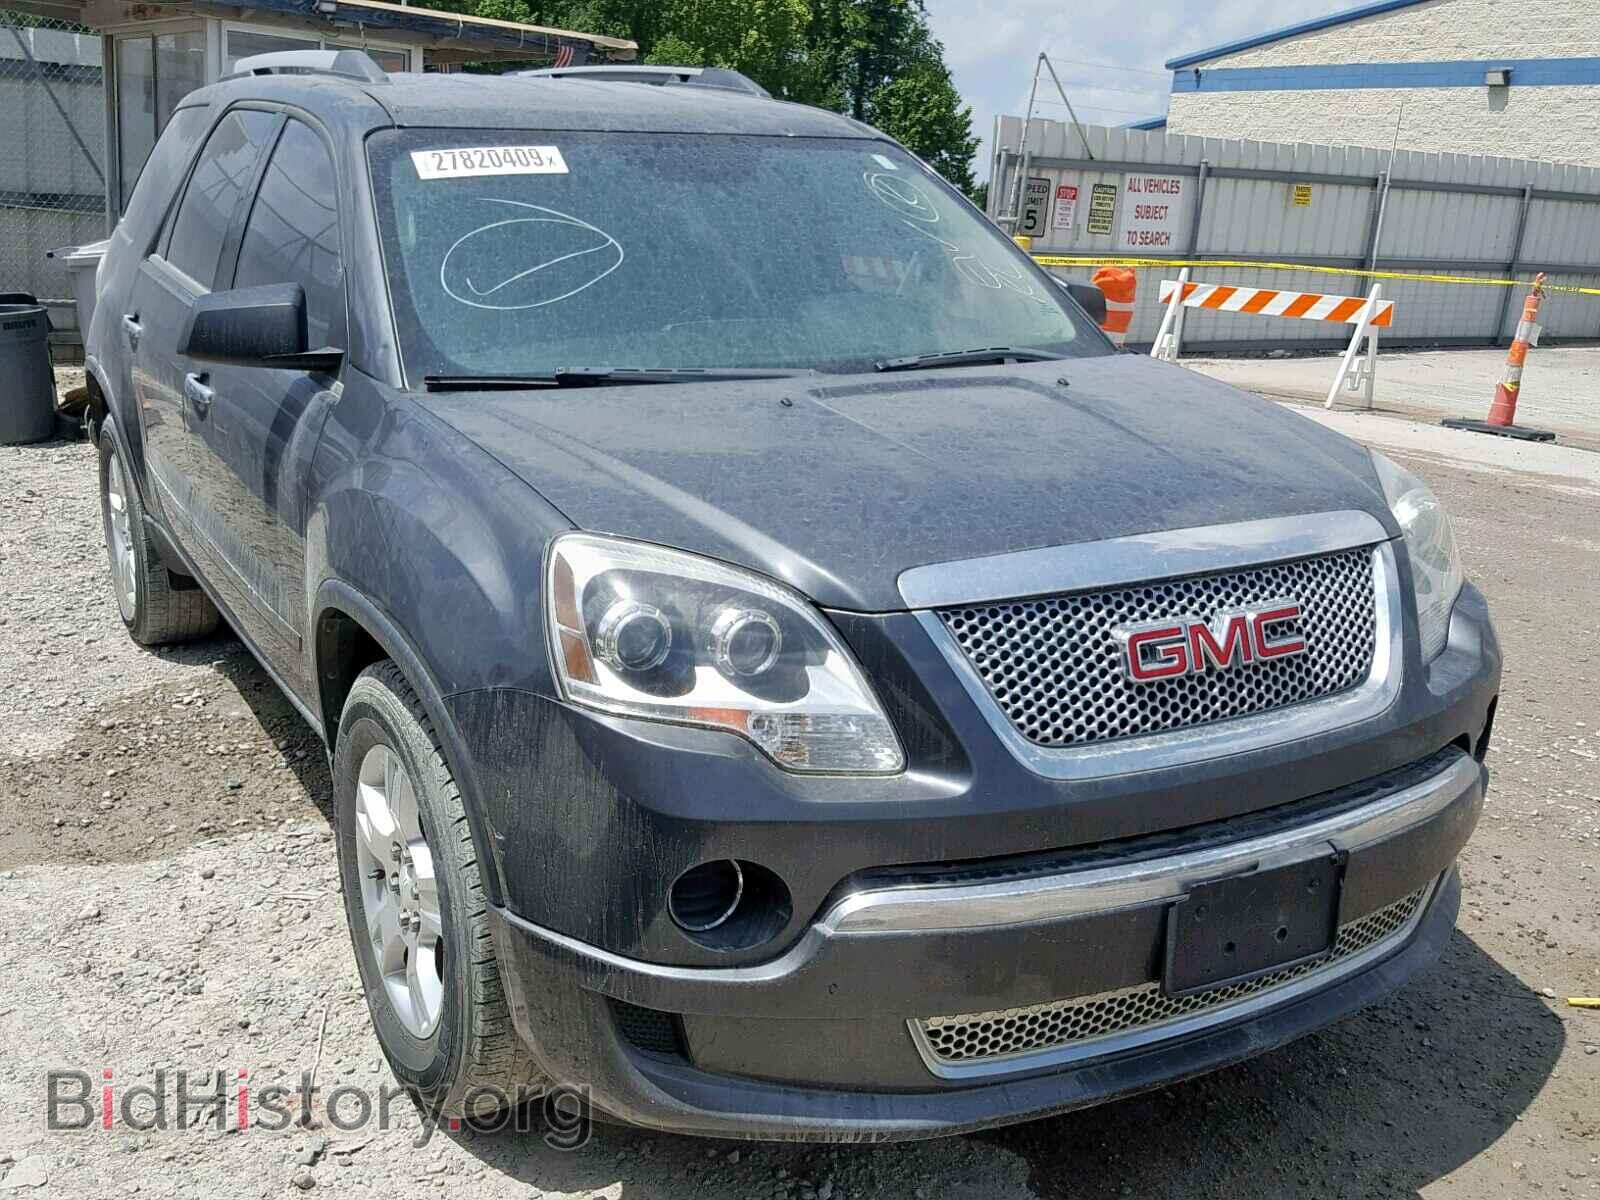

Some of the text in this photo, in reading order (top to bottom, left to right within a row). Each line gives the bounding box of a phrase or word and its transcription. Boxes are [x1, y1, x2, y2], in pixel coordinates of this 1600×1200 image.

[431, 148, 545, 172] 27820409
[1026, 185, 1048, 194] PEED
[1059, 188, 1076, 200] STOP
[1128, 178, 1180, 194] ALL VEHICLES
[1024, 209, 1037, 230] 5
[1134, 204, 1168, 220] SUBJECT
[1128, 231, 1171, 247] TO SEARCH
[1126, 605, 1306, 682] GMC
